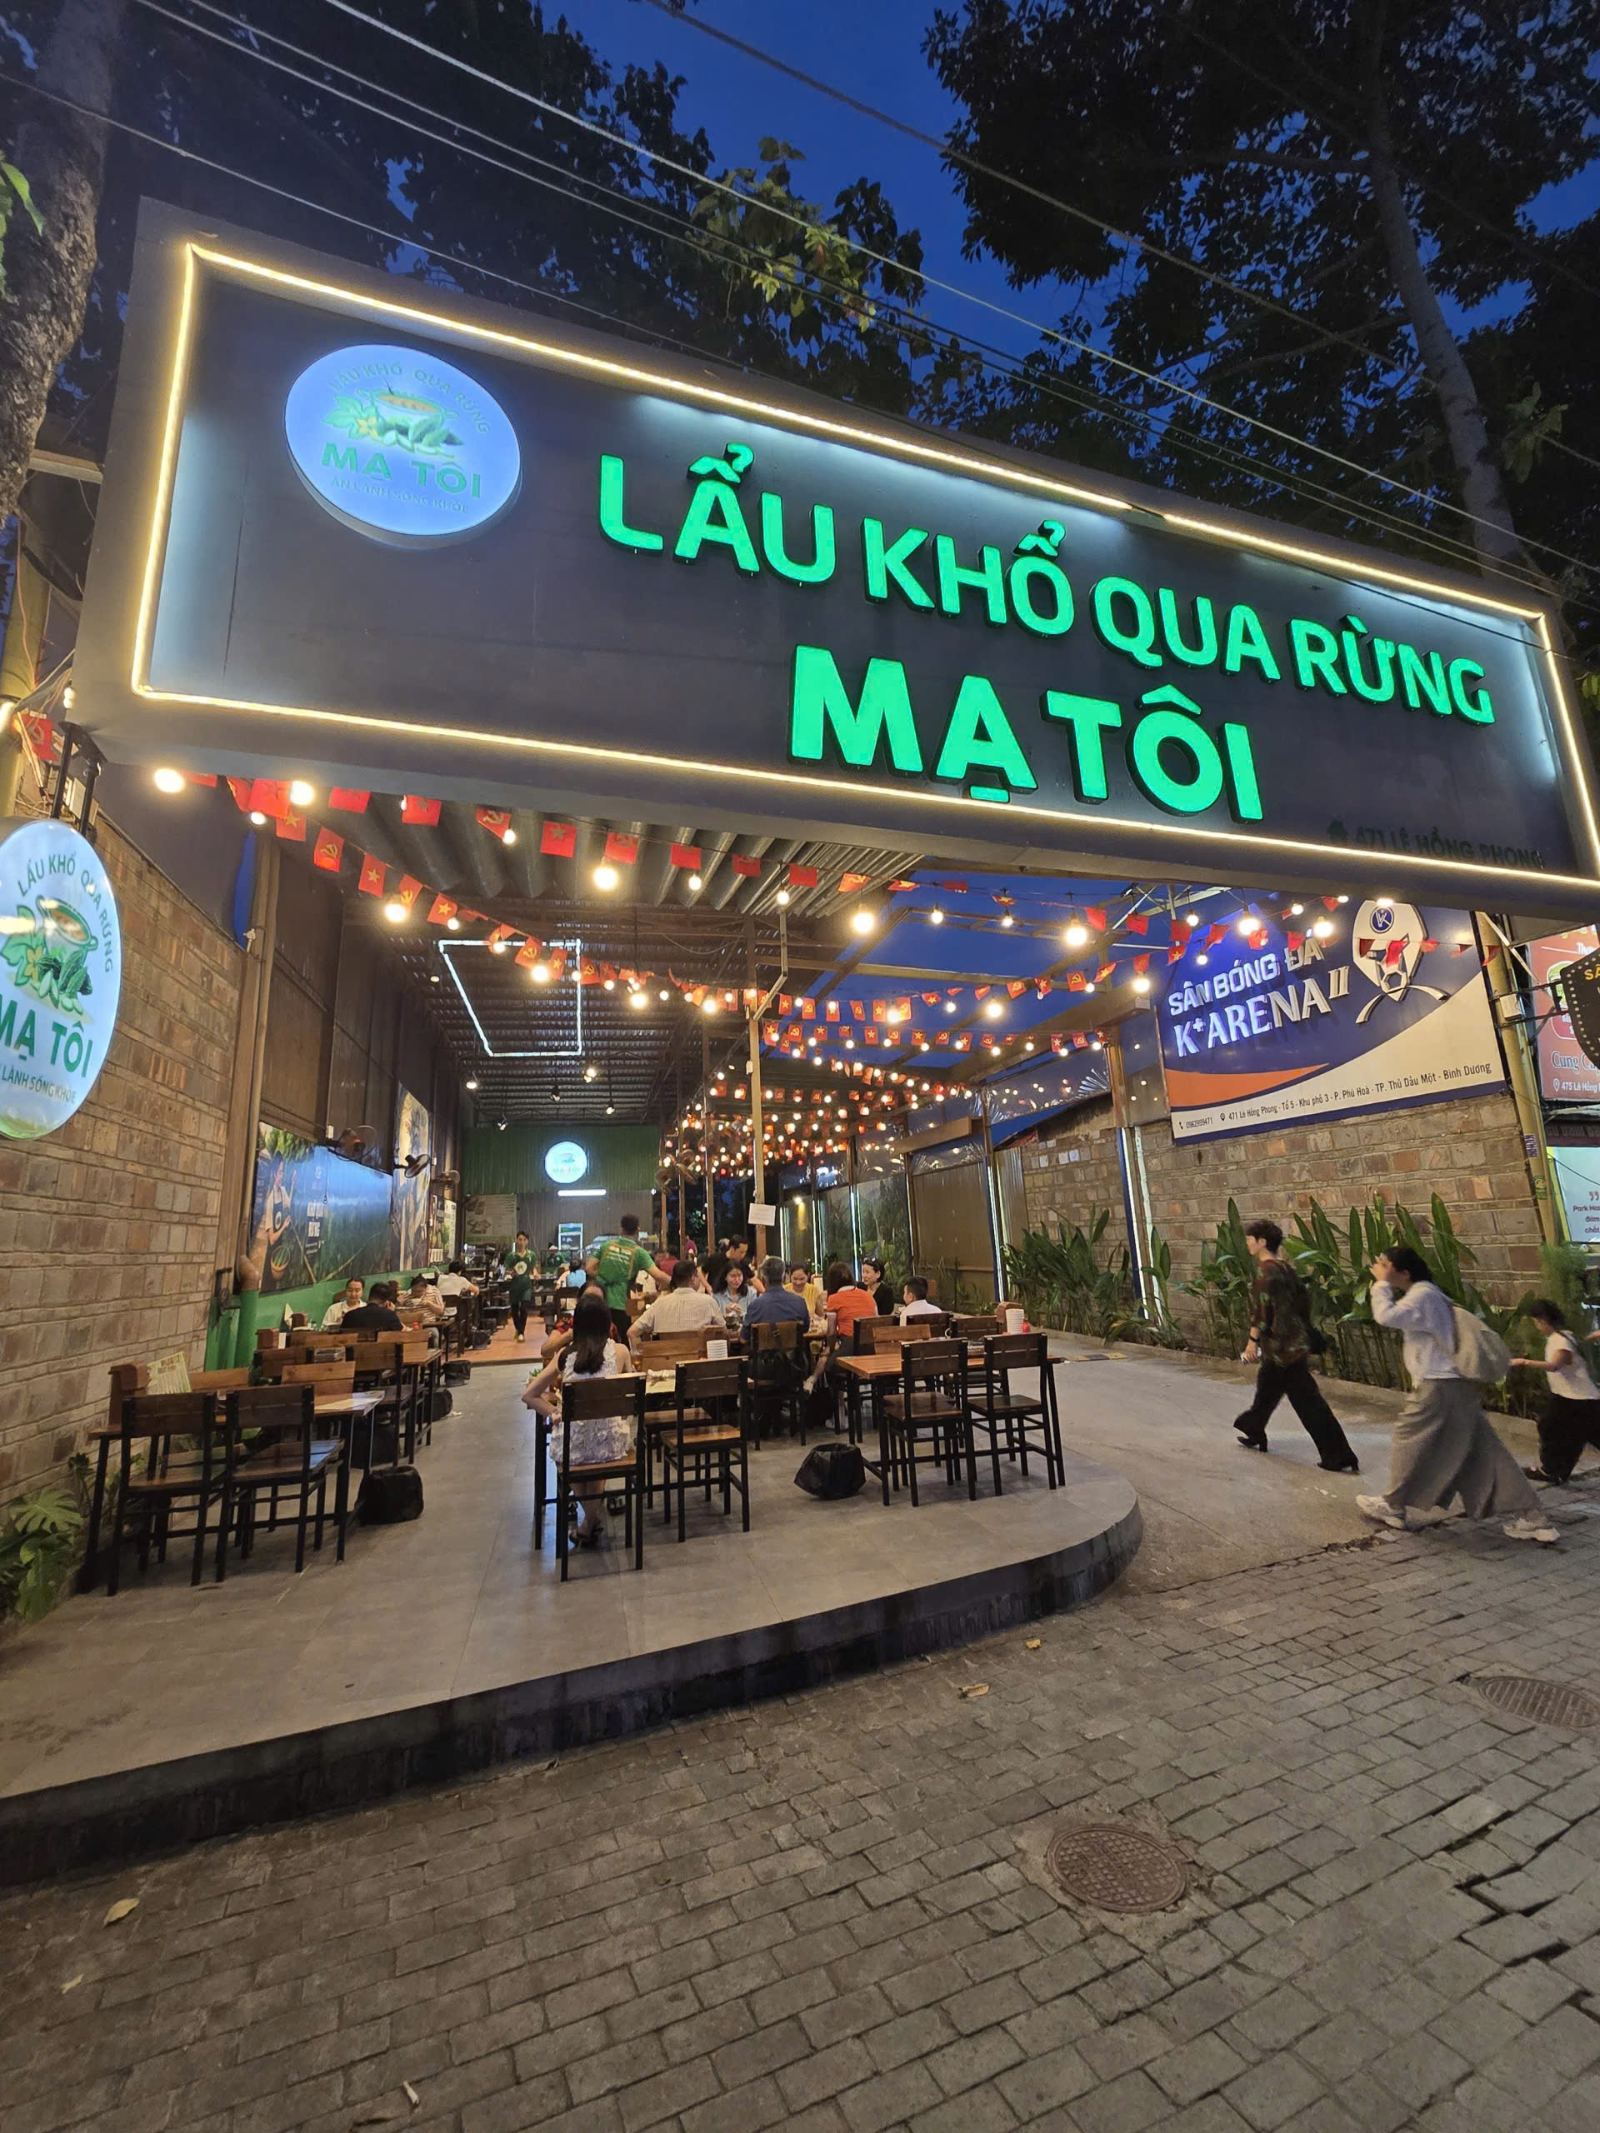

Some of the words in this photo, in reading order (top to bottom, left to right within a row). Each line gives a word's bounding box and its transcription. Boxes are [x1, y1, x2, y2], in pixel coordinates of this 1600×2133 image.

[321, 442, 393, 481] MẠ
[411, 460, 482, 499] TÔI
[600, 442, 836, 584] LẨU
[862, 518, 1076, 636] KHỔ
[1092, 576, 1281, 682] QUA
[1288, 614, 1496, 725] RỪNG
[791, 644, 1039, 803] MẠ
[1045, 683, 1264, 821] TÔI
[1168, 980, 1214, 1016] SÂN
[1212, 953, 1281, 999] BÓNG
[50, 1020, 93, 1078] TÔI
[1229, 1111, 1238, 1120] 471
[1299, 1097, 1311, 1107] Khu
[1324, 1094, 1329, 1103] 3
[1375, 1083, 1388, 1093] TP.
[1421, 1072, 1437, 1084] Một
[1464, 1062, 1492, 1076] Dương
